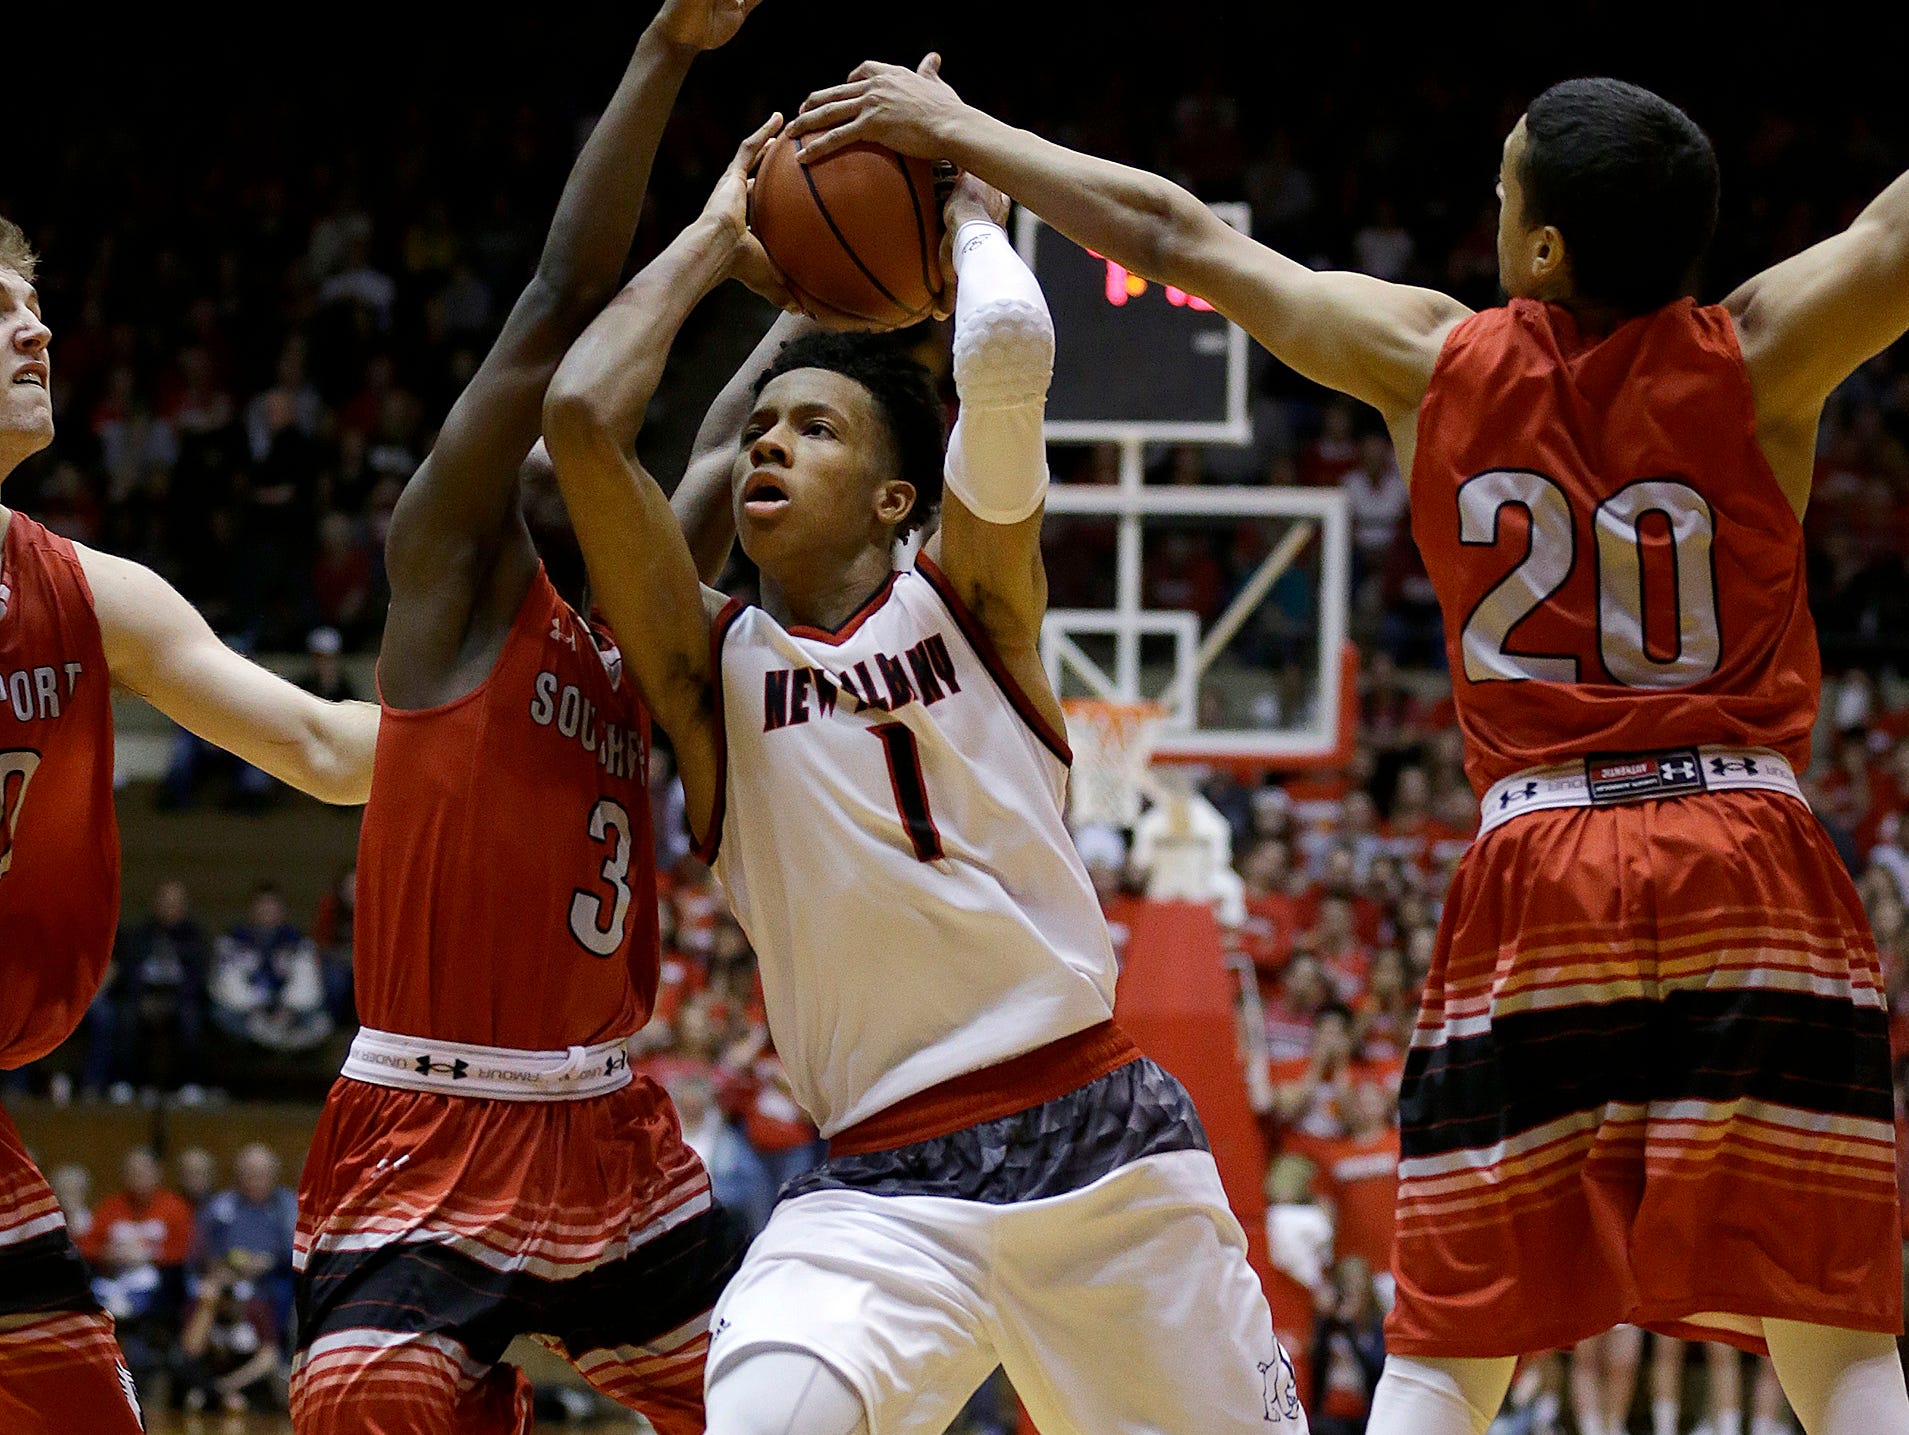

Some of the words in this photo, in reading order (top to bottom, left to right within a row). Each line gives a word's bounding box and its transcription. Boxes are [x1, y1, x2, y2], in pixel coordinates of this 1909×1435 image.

[1457, 468, 1722, 690] 20
[763, 666, 838, 732] NEW
[839, 632, 962, 713] ALBNY
[865, 721, 945, 862] 1
[567, 797, 632, 958] 3
